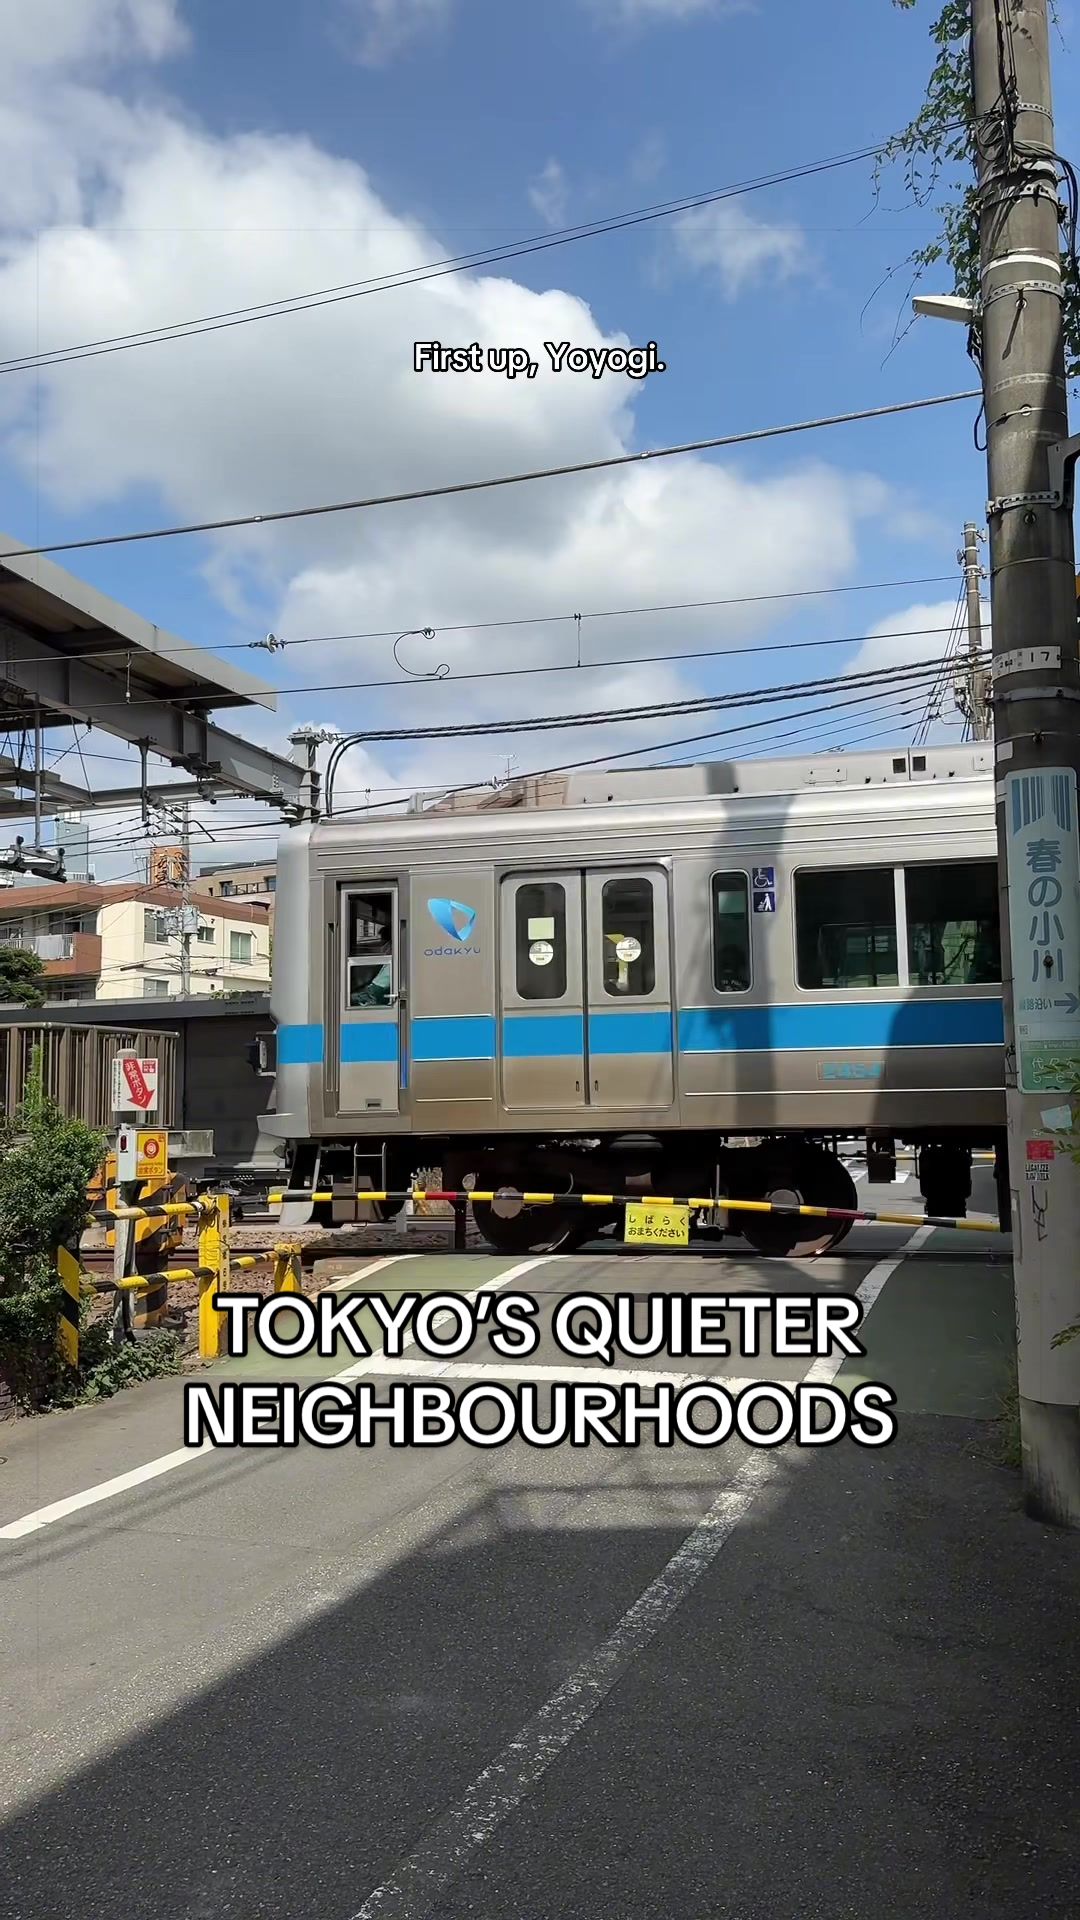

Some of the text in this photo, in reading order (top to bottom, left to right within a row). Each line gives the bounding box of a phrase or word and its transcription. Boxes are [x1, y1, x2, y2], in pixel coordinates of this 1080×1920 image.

[1026, 838, 1064, 983] 春の小川
[424, 945, 481, 956] odakyu
[124, 1061, 147, 1105] 非常ボタン
[629, 1214, 686, 1226] しばらく
[628, 1227, 685, 1238] おまちください
